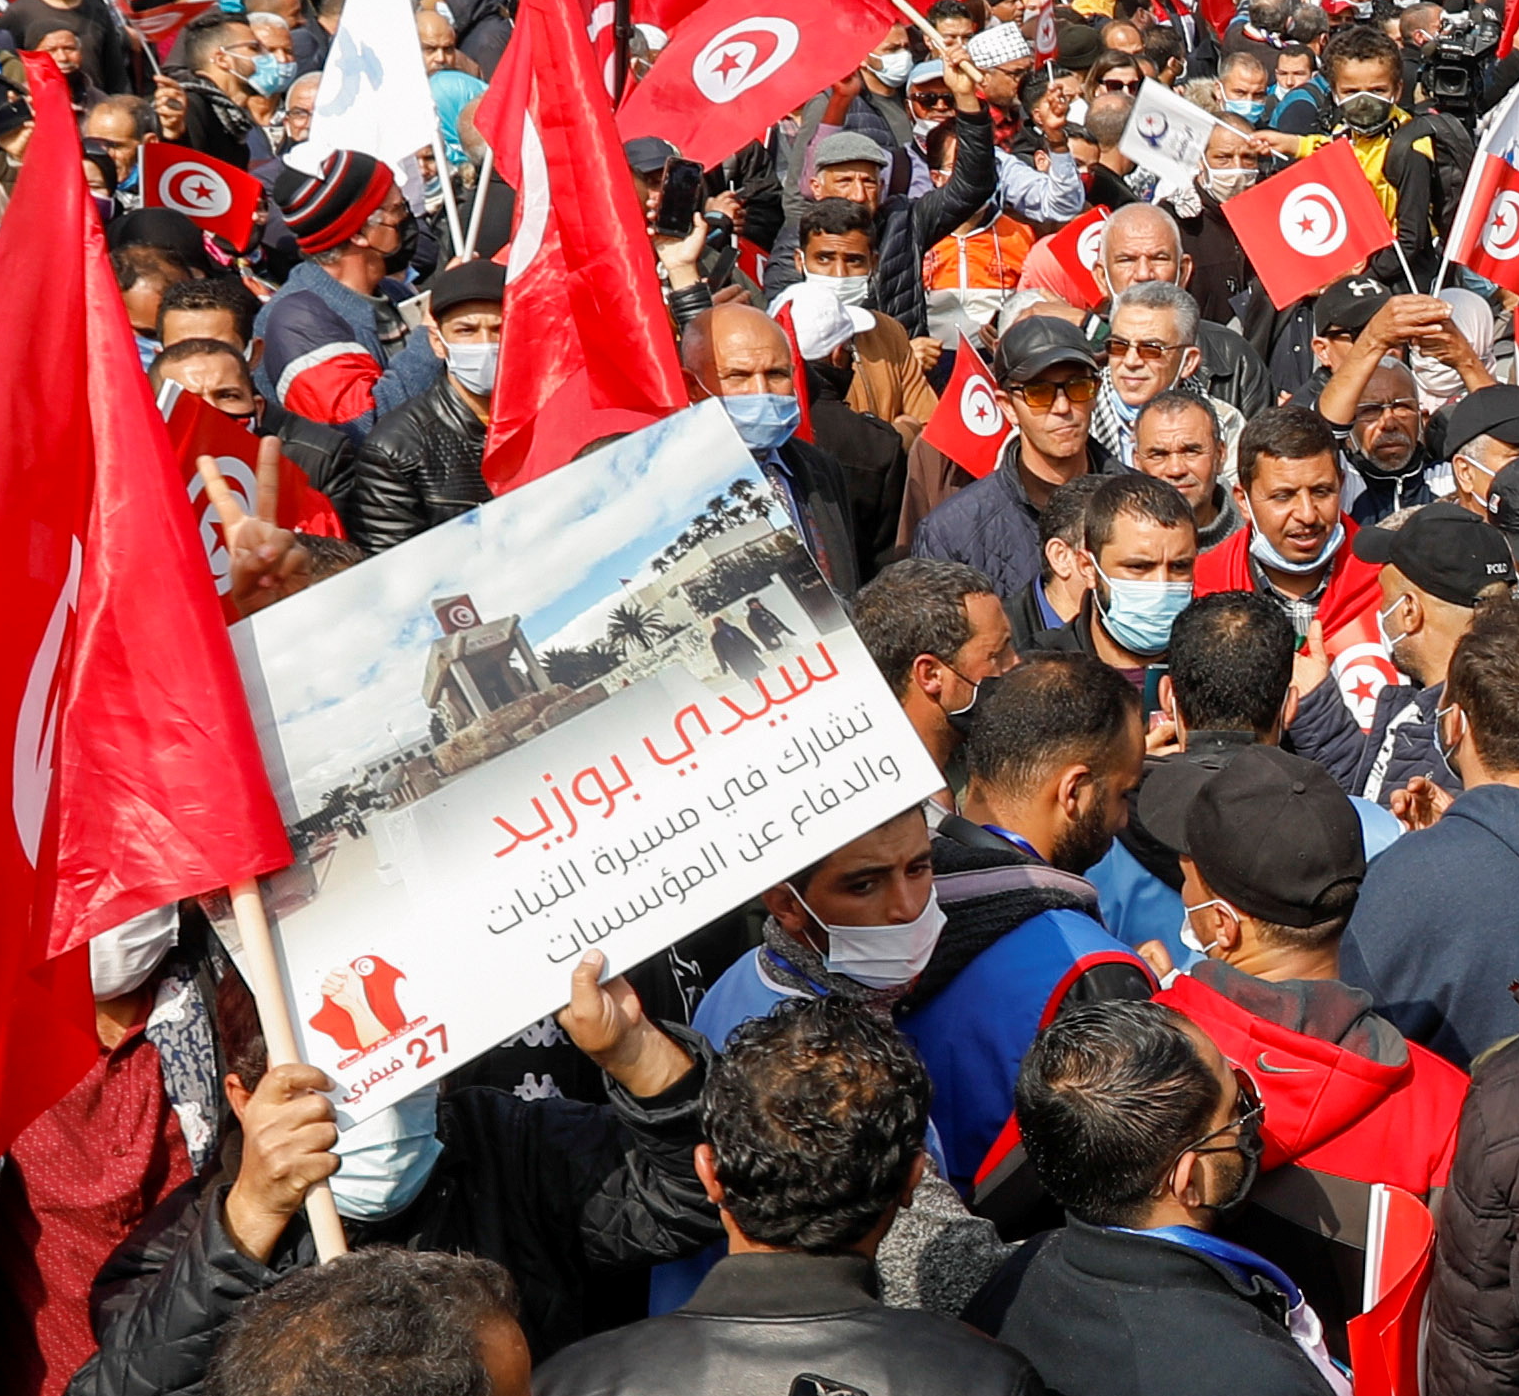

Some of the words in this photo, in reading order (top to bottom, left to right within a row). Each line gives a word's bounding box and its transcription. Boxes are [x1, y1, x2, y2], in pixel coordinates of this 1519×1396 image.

[642, 641, 840, 777] سيدي
[776, 702, 874, 775] تشارك
[492, 754, 642, 859] بوزيد
[707, 764, 769, 818] في
[790, 753, 902, 836] والدفاع
[593, 806, 701, 876] مسيرة
[738, 820, 784, 863] عن
[487, 859, 587, 936] الثبات
[547, 841, 728, 965] المؤسسات
[342, 1055, 405, 1105] فيفري
[406, 1023, 449, 1070] 27
